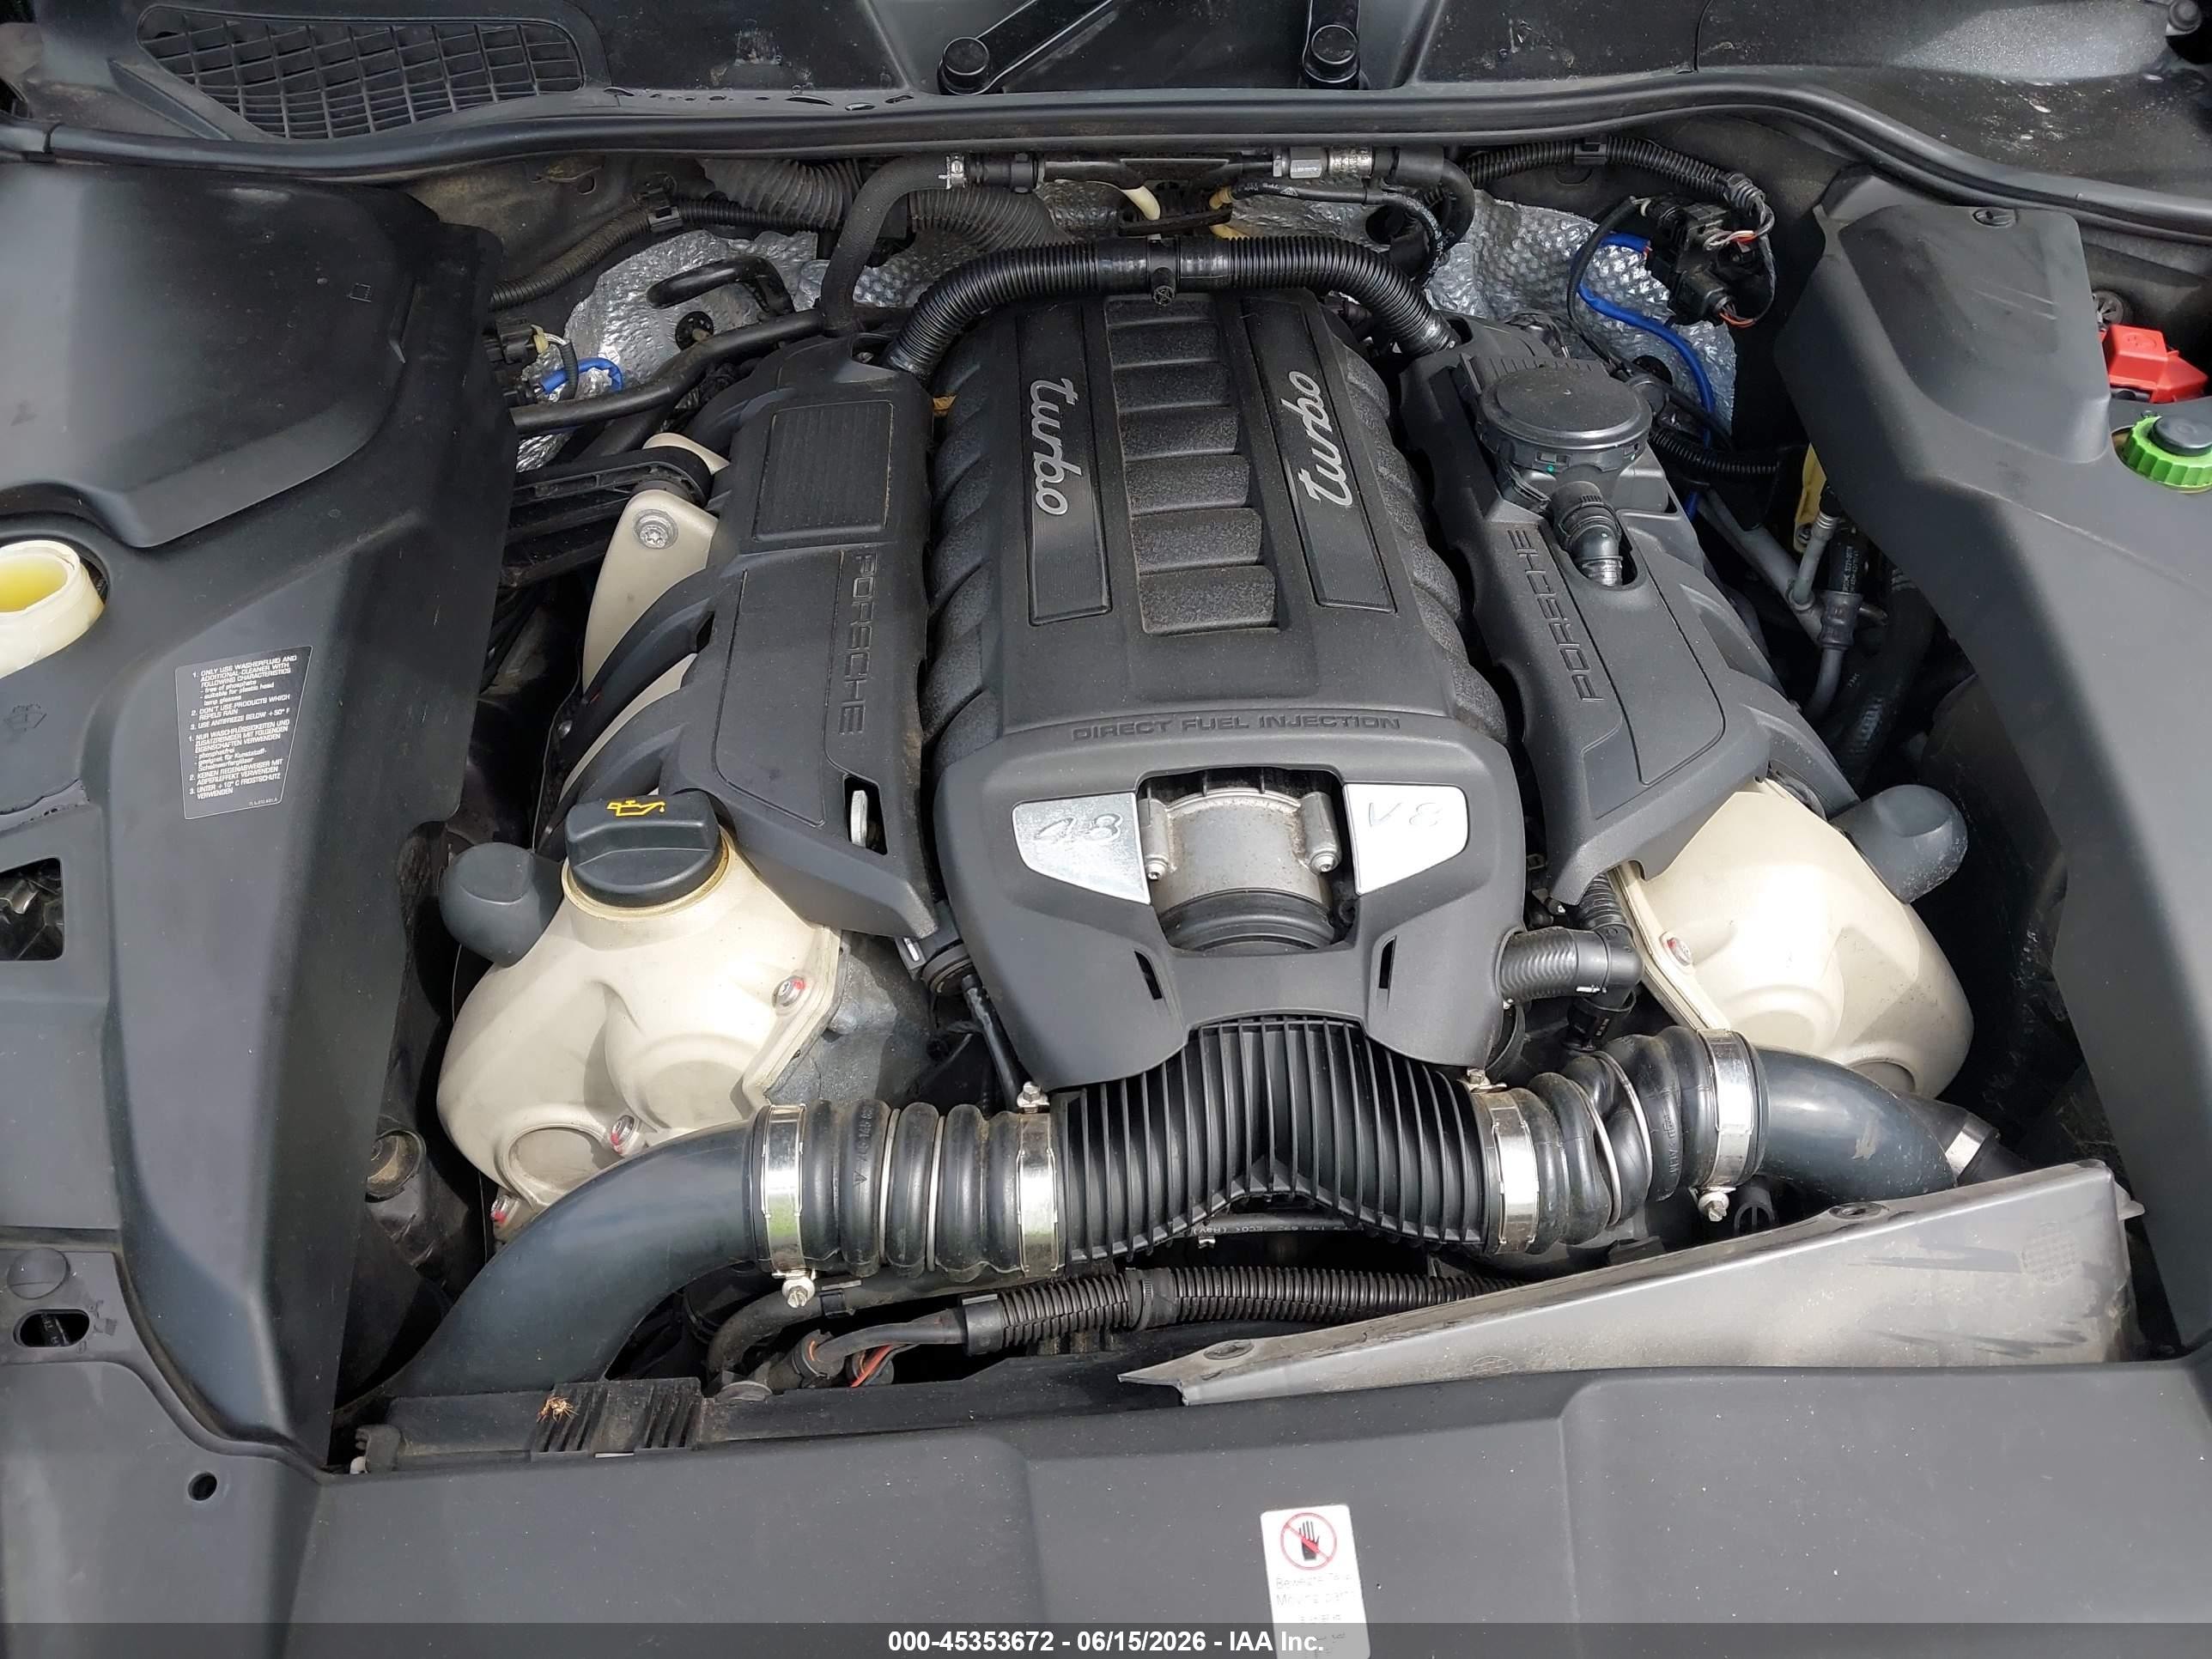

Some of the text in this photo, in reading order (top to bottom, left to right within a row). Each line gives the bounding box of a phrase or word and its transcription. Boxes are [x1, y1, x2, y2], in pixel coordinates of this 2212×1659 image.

[1030, 378, 1082, 515] turbo
[1280, 370, 1353, 506] turbo
[1508, 530, 1606, 702] PORSCHE
[839, 551, 878, 735] PORSCHE
[200, 667, 218, 677] ONLY
[220, 665, 234, 673] USE
[282, 655, 297, 664] AND
[201, 667, 291, 688] FOLLOWING CHARACTERISTICS
[199, 706, 219, 715] DON'T
[234, 697, 267, 708] PRODUCTS
[269, 694, 290, 702] WHICH
[223, 708, 239, 717] RAIN
[246, 711, 266, 720] BELOW
[196, 732, 209, 741] NUR
[1072, 714, 1401, 742] DIRECT FUEL INJECTION
[244, 733, 281, 745] VERWENDEN
[197, 770, 219, 779] KEINEN
[241, 766, 279, 777] VERWENDEN
[197, 784, 216, 793] UNTER
[240, 773, 281, 785] FROSTSCHUTZ
[197, 787, 234, 799] VERWENDEN
